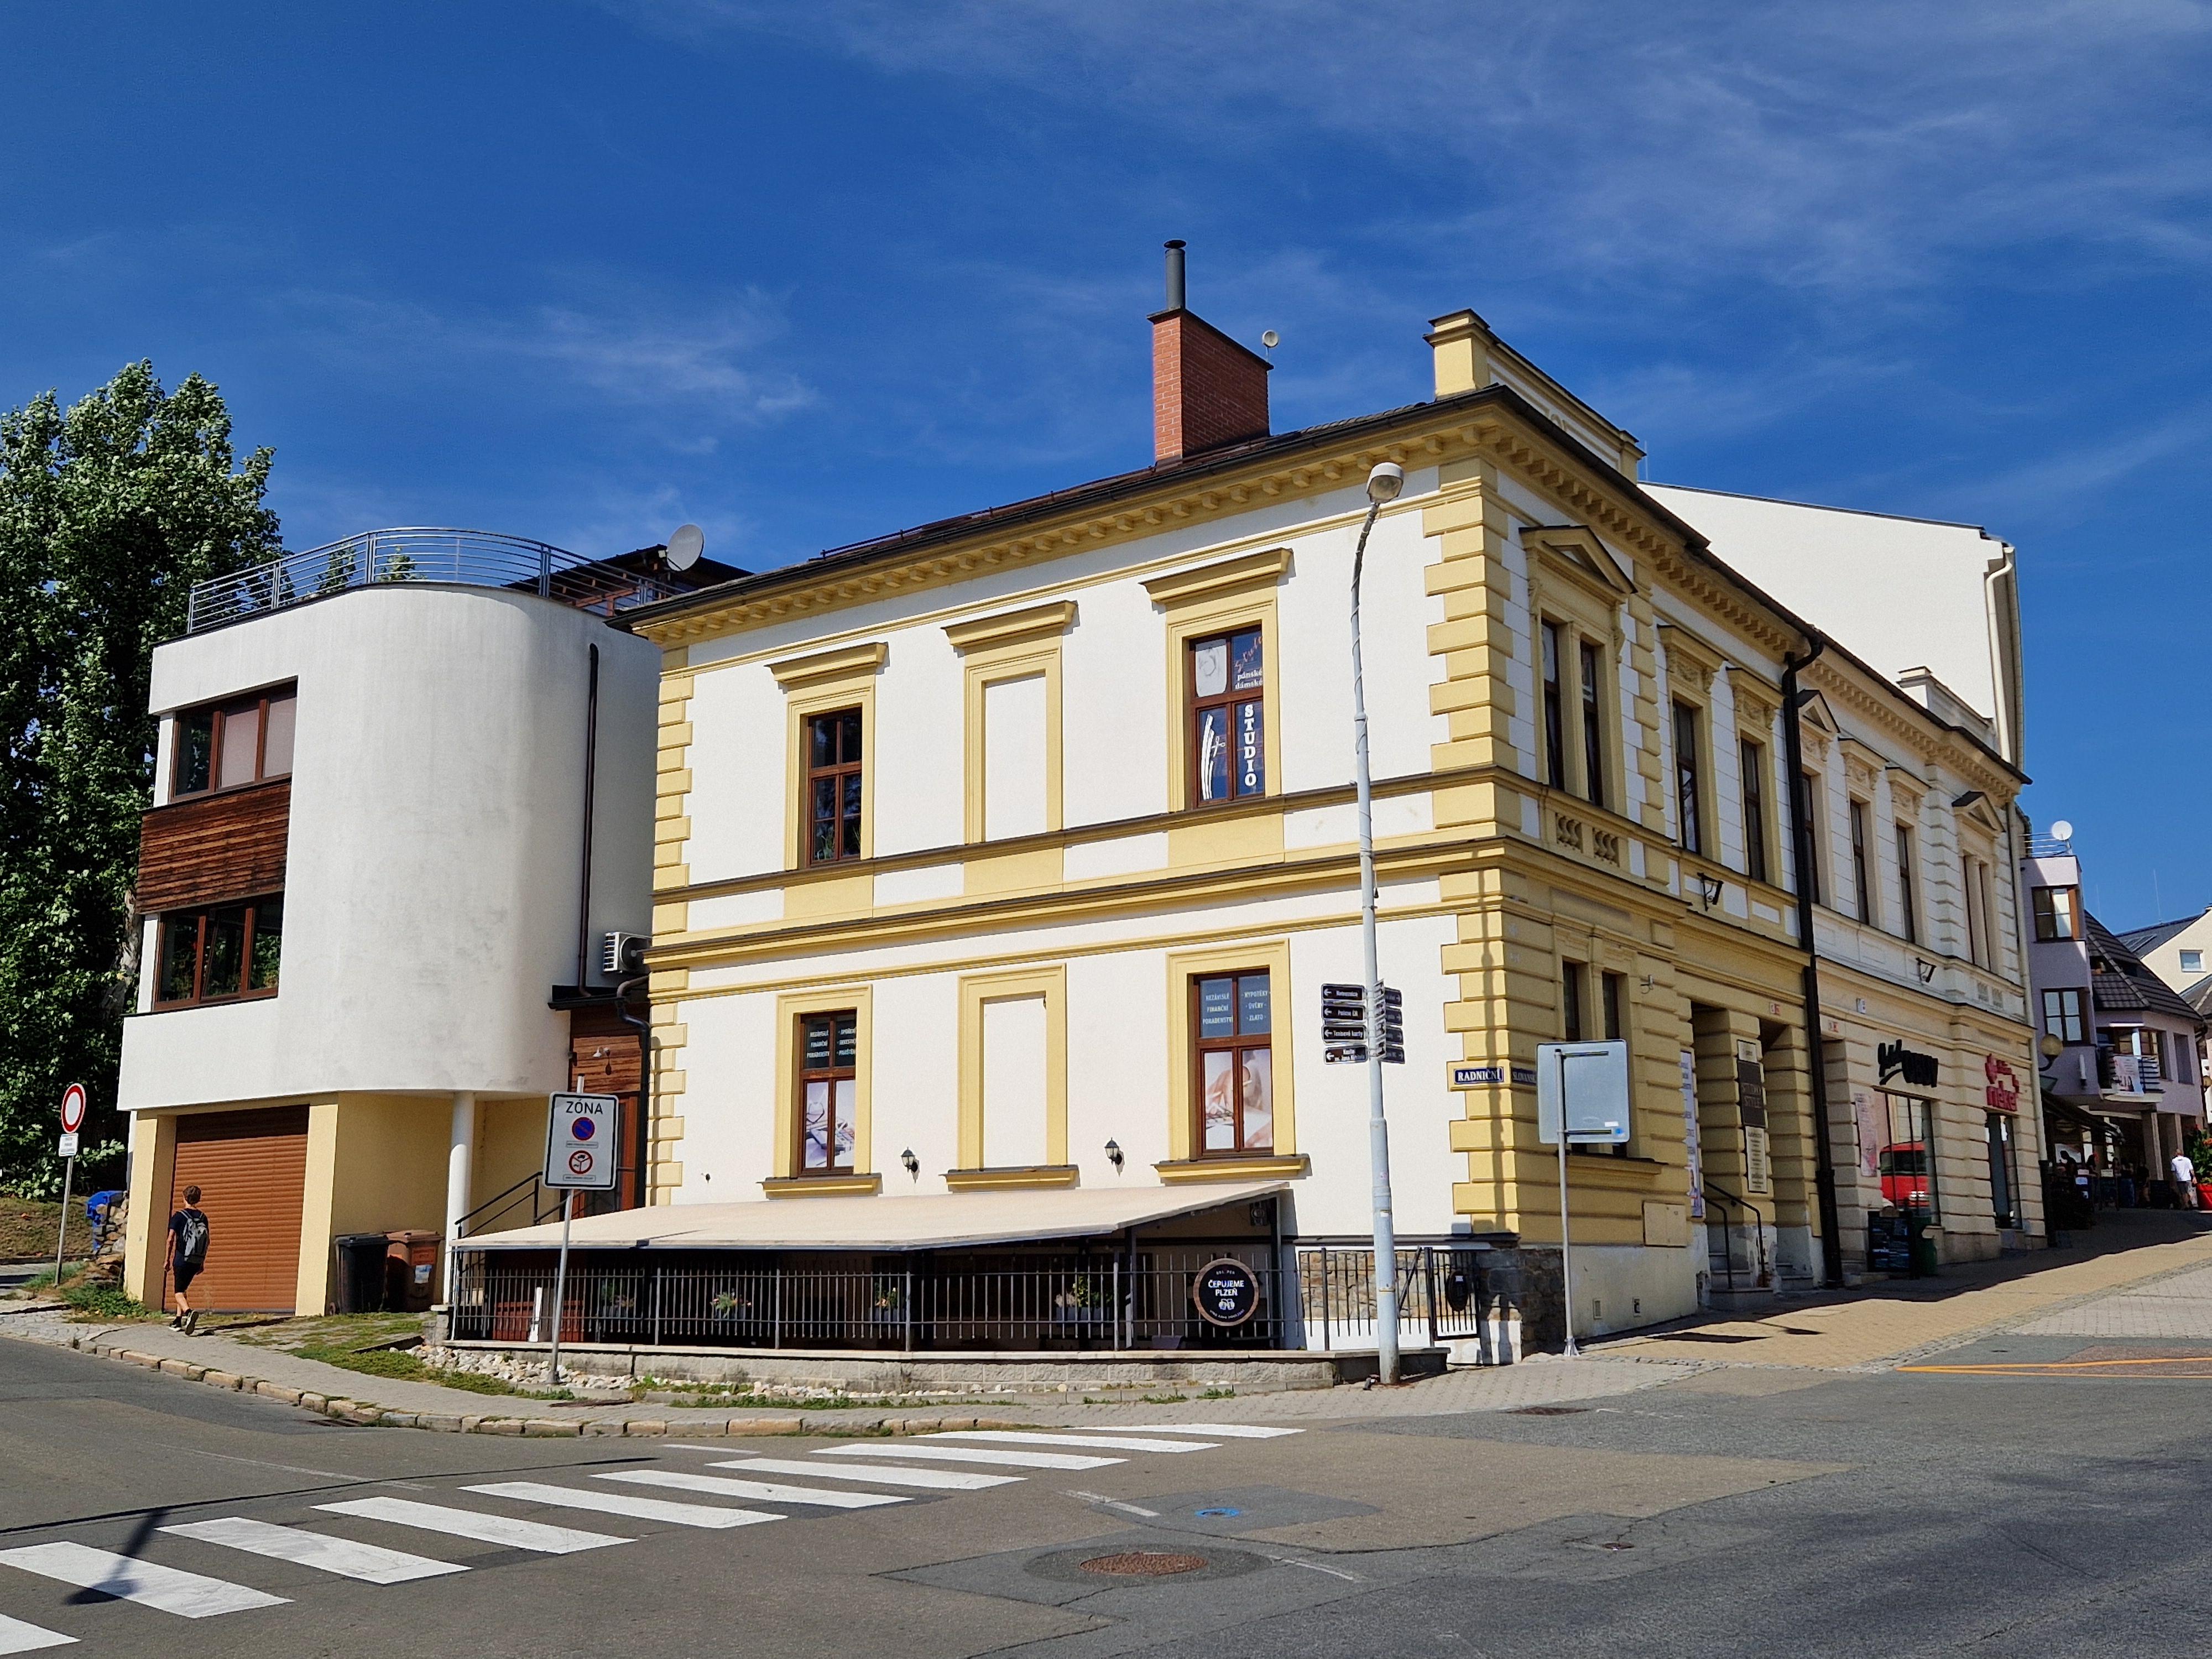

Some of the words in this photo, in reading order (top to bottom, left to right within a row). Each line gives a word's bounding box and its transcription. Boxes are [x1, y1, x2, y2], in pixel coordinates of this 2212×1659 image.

[1244, 703, 1257, 786] STUDIO
[1458, 1068, 1501, 1082] RADNIČNÍ
[566, 1099, 603, 1115] ZÓNA
[1208, 1279, 1244, 1288] ČEPUJEME
[1215, 1288, 1238, 1297] PLZEŇ
